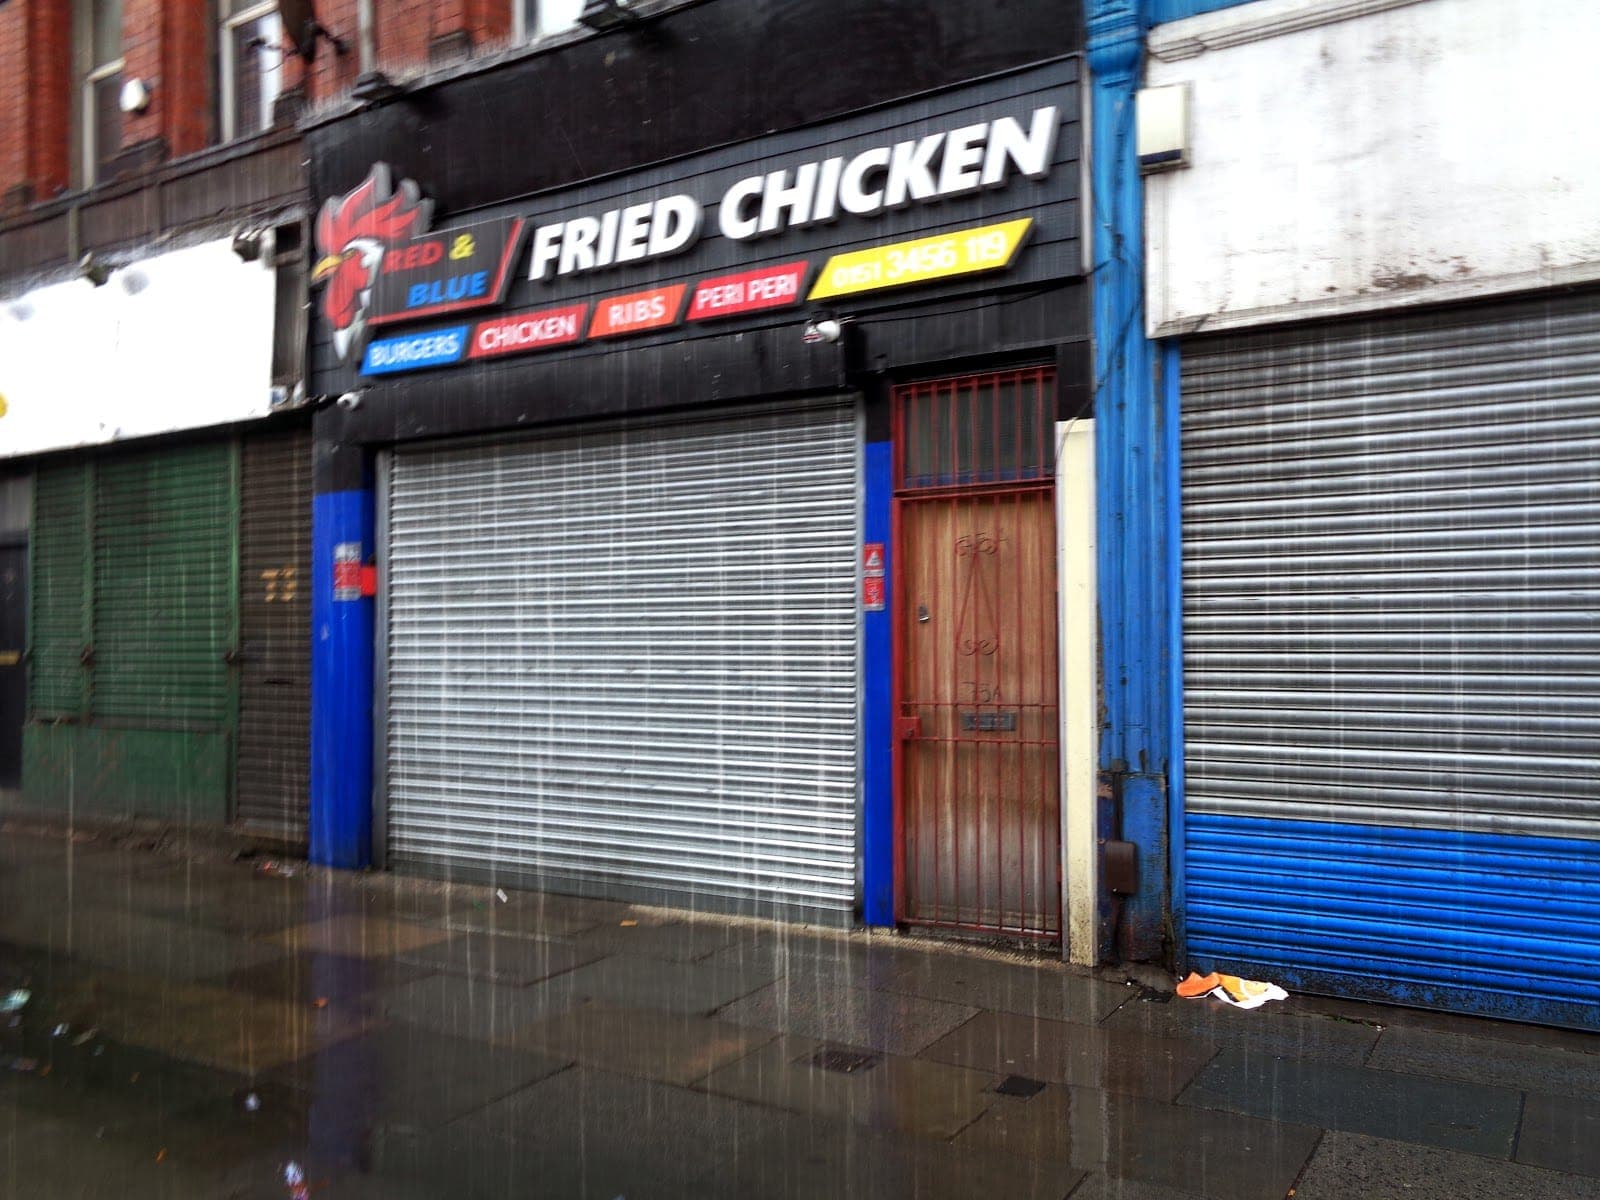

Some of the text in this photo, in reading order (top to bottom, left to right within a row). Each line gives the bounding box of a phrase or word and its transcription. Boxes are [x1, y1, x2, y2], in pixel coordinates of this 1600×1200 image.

[528, 106, 1059, 281] FRIED CHICKEN
[383, 233, 476, 273] RED &
[886, 240, 957, 279] 3456
[406, 270, 489, 308] BLUE
[696, 272, 798, 312] PERI PERI
[610, 294, 666, 328] RIBS
[369, 333, 460, 368] BURGERS
[479, 314, 577, 350] CHICKEN
